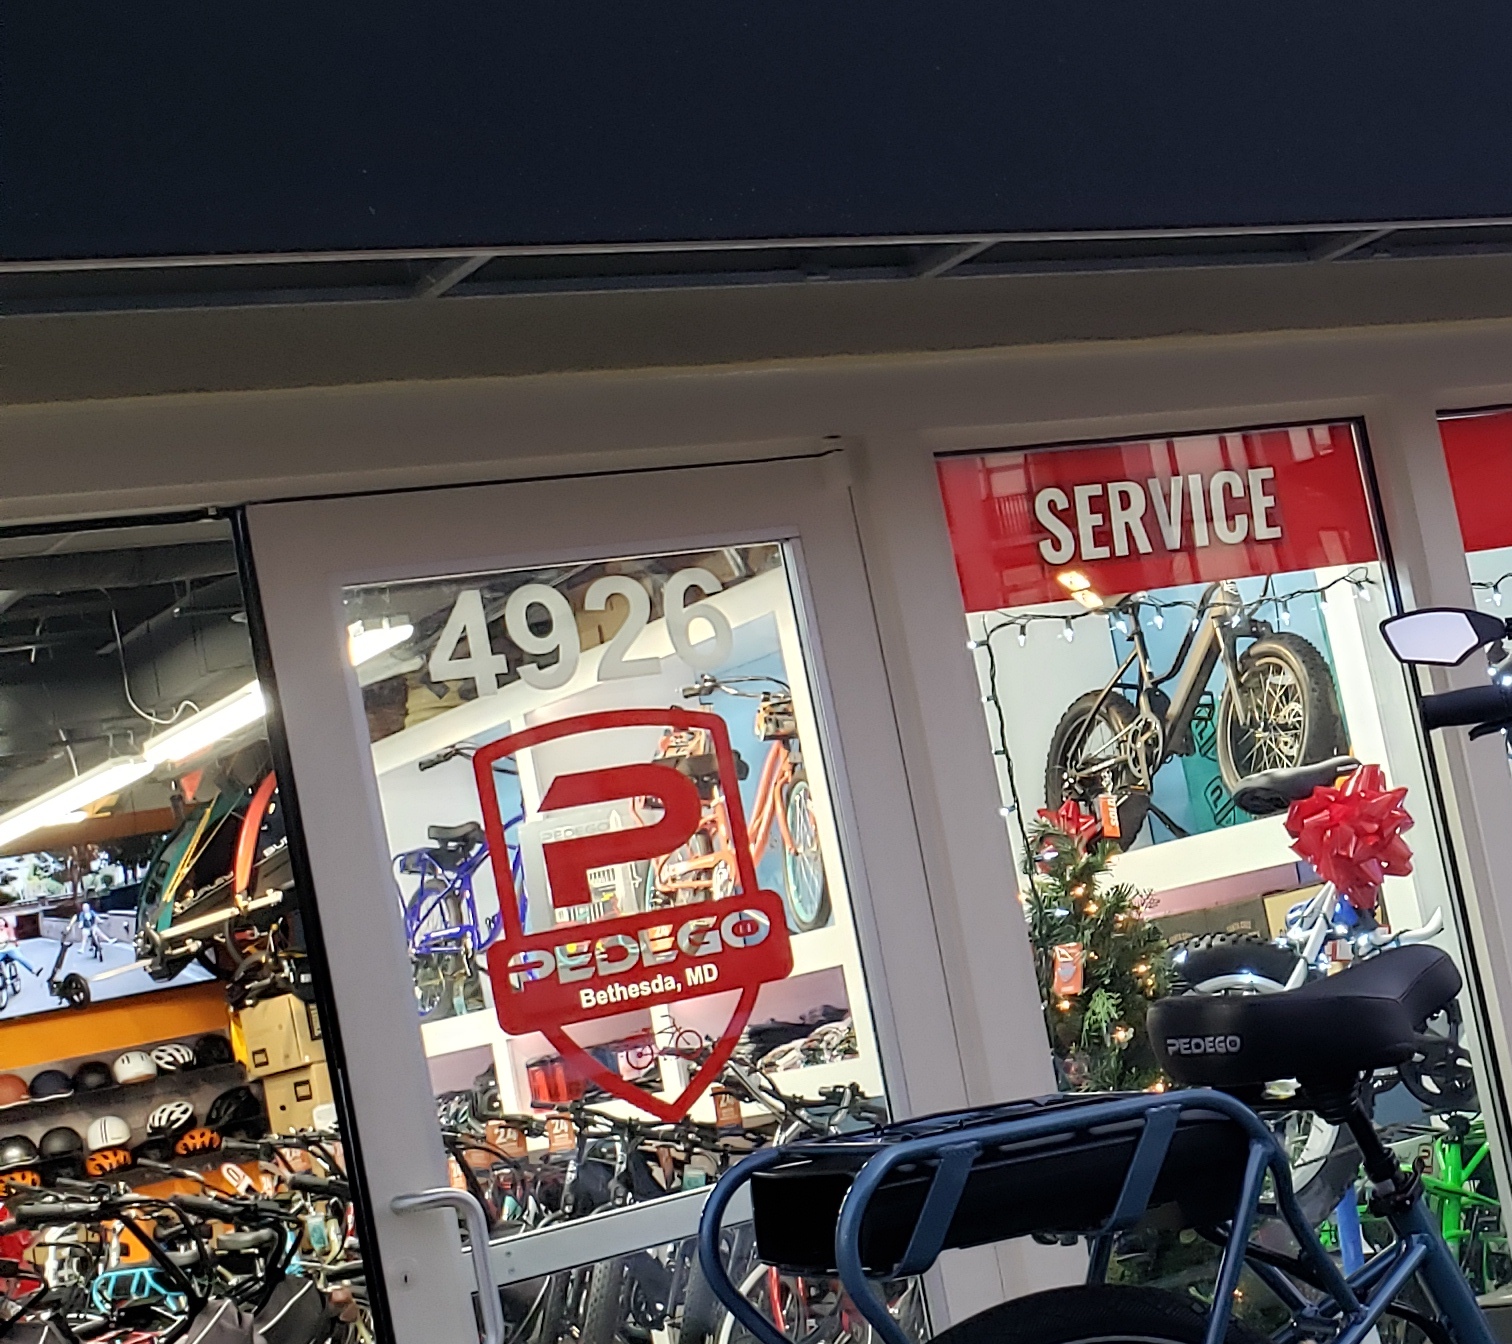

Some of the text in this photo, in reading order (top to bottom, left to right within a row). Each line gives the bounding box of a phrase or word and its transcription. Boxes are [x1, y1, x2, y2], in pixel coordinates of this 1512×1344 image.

[1033, 466, 1283, 565] SERVICE
[428, 567, 734, 697] 4926
[508, 909, 771, 993] PEDEGO
[579, 962, 720, 1010] Bethesda, MD
[1166, 1035, 1241, 1056] PEDEGO
